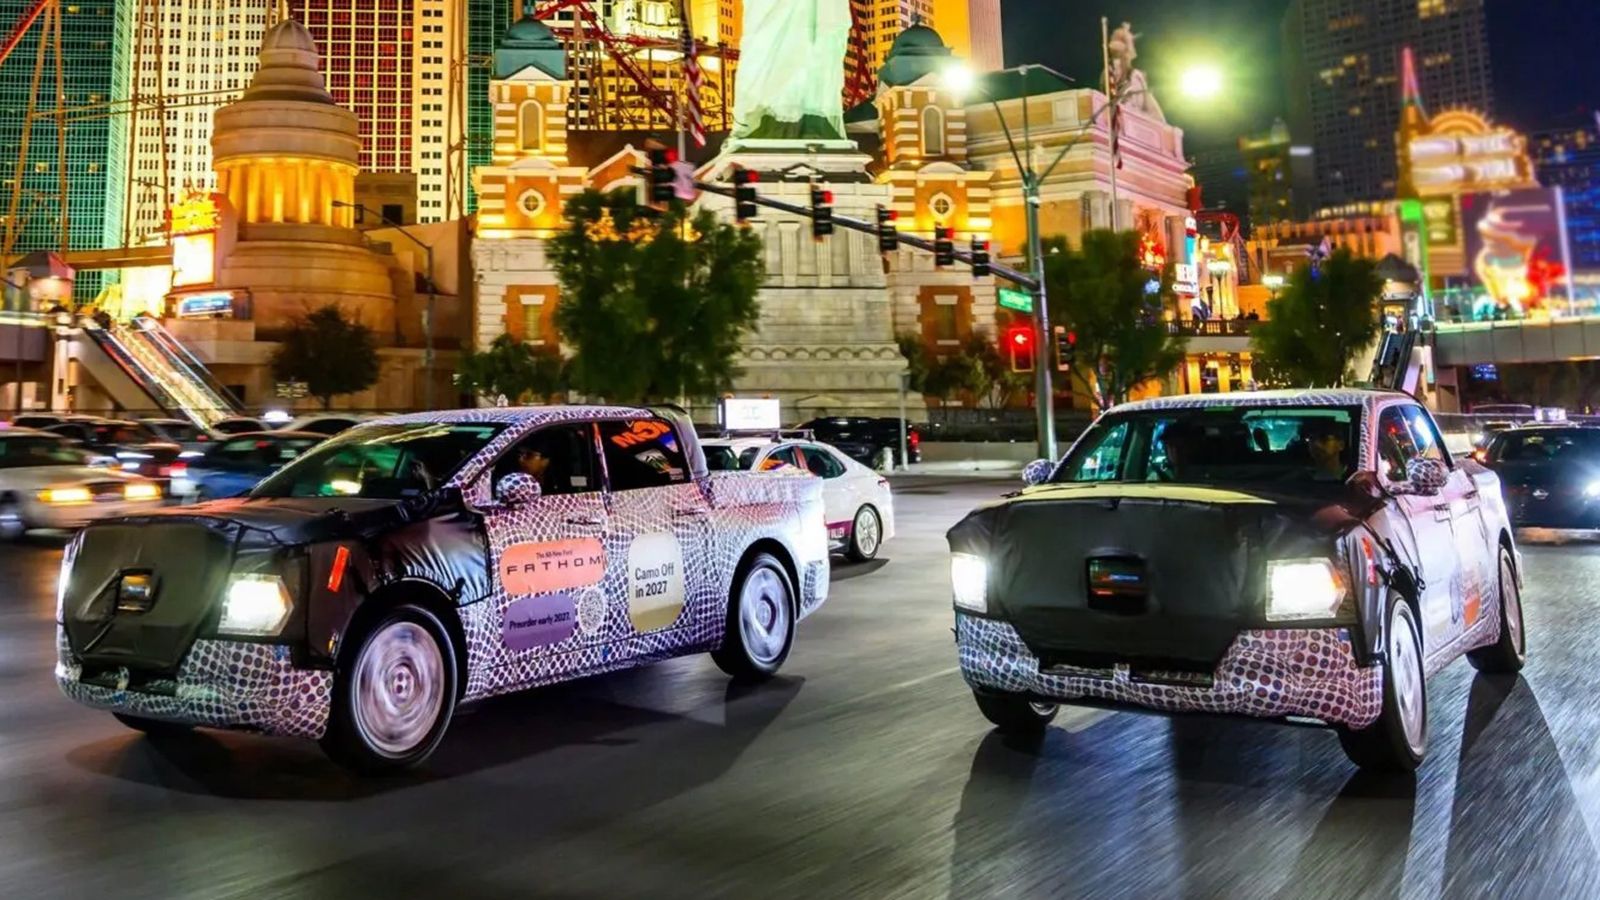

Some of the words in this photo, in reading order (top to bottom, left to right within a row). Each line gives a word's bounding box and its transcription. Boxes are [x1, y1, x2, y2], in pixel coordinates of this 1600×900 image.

[506, 556, 601, 575] FATHOM
[635, 567, 660, 580] Camo
[661, 562, 674, 576] Off
[635, 585, 644, 598] in
[645, 580, 667, 597] 2027
[509, 618, 537, 630] Preorder
